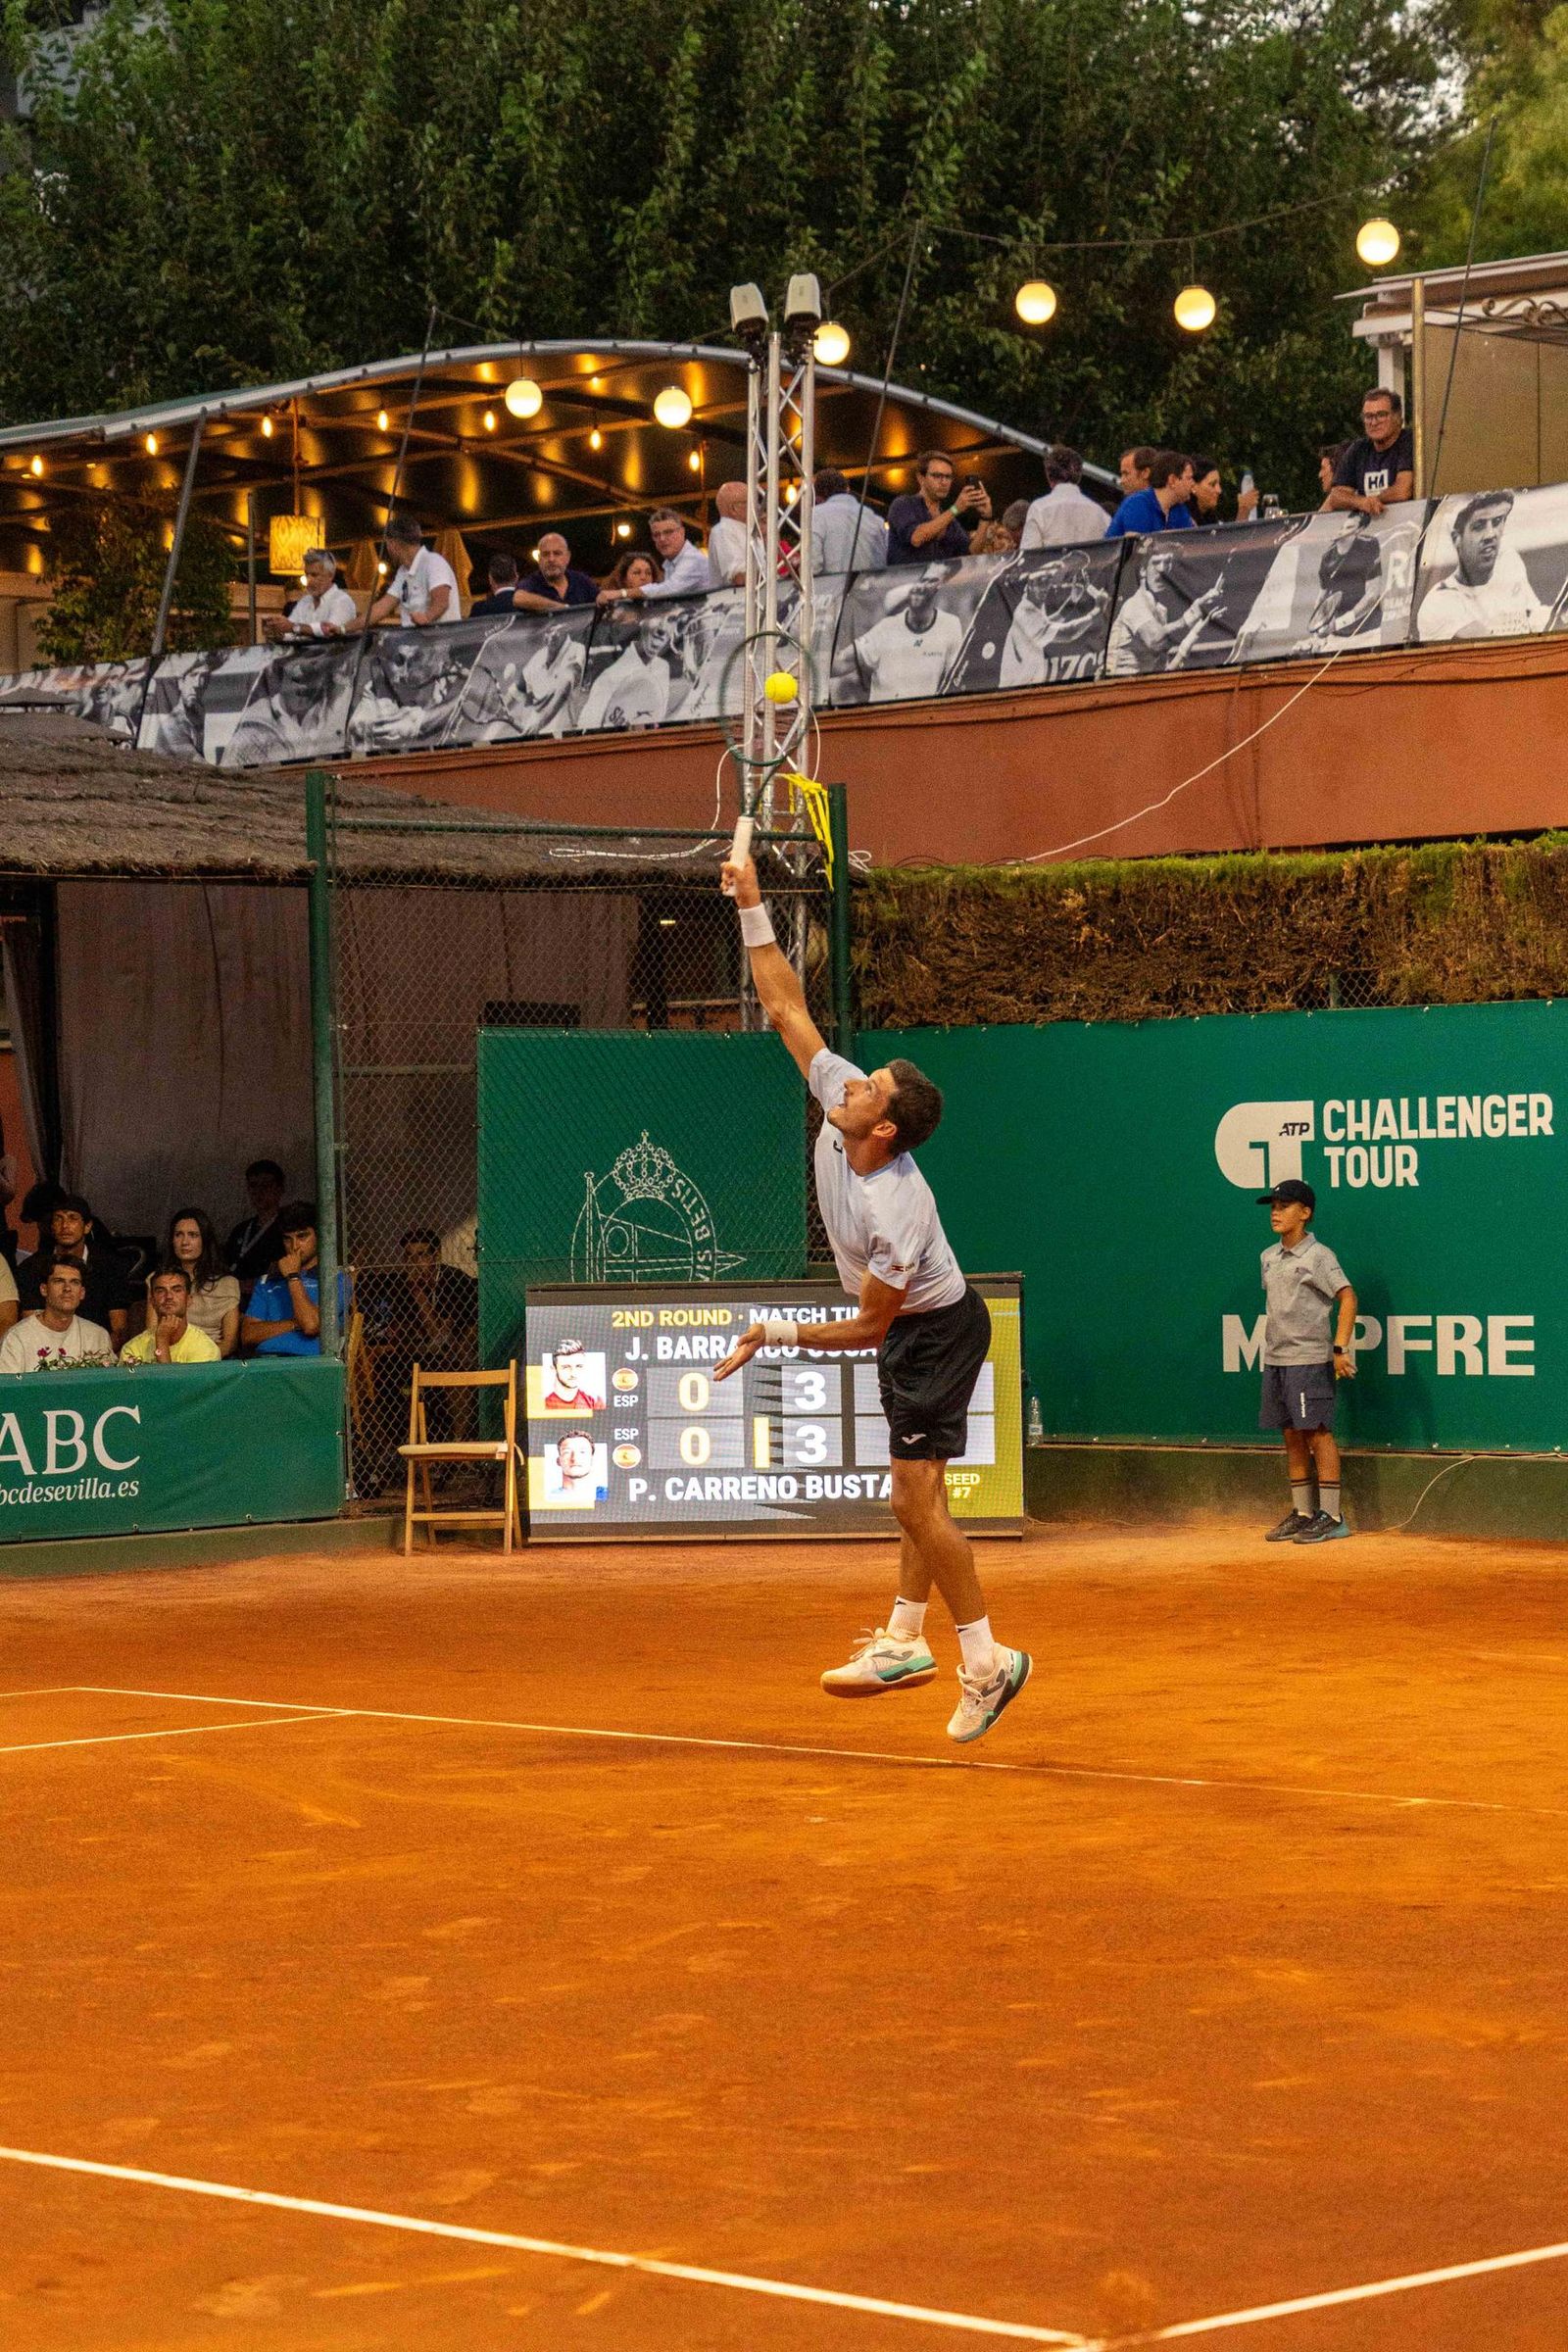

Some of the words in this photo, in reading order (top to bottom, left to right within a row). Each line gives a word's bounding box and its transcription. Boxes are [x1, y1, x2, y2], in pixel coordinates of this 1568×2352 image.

[1279, 1122, 1310, 1136] ATP
[1323, 1093, 1554, 1142] CHALLENGER
[1323, 1146, 1419, 1188] TOUR
[671, 1179, 710, 1241] BETIS
[612, 1310, 655, 1327] 2ND
[659, 1308, 732, 1327] ROUND
[749, 1307, 828, 1324] MATCH
[625, 1336, 649, 1360] J.
[1222, 1314, 1535, 1376] MPFRE
[613, 1396, 638, 1407] ESP
[678, 1372, 710, 1412] 0
[794, 1371, 826, 1410] 3
[0, 1404, 141, 1475] ABC
[613, 1429, 639, 1441] ESP
[679, 1426, 710, 1466] 0
[795, 1424, 828, 1464] 3
[628, 1478, 657, 1501] P.
[664, 1476, 798, 1501] CARRENO
[944, 1474, 980, 1486] SEED
[953, 1487, 971, 1498] #7
